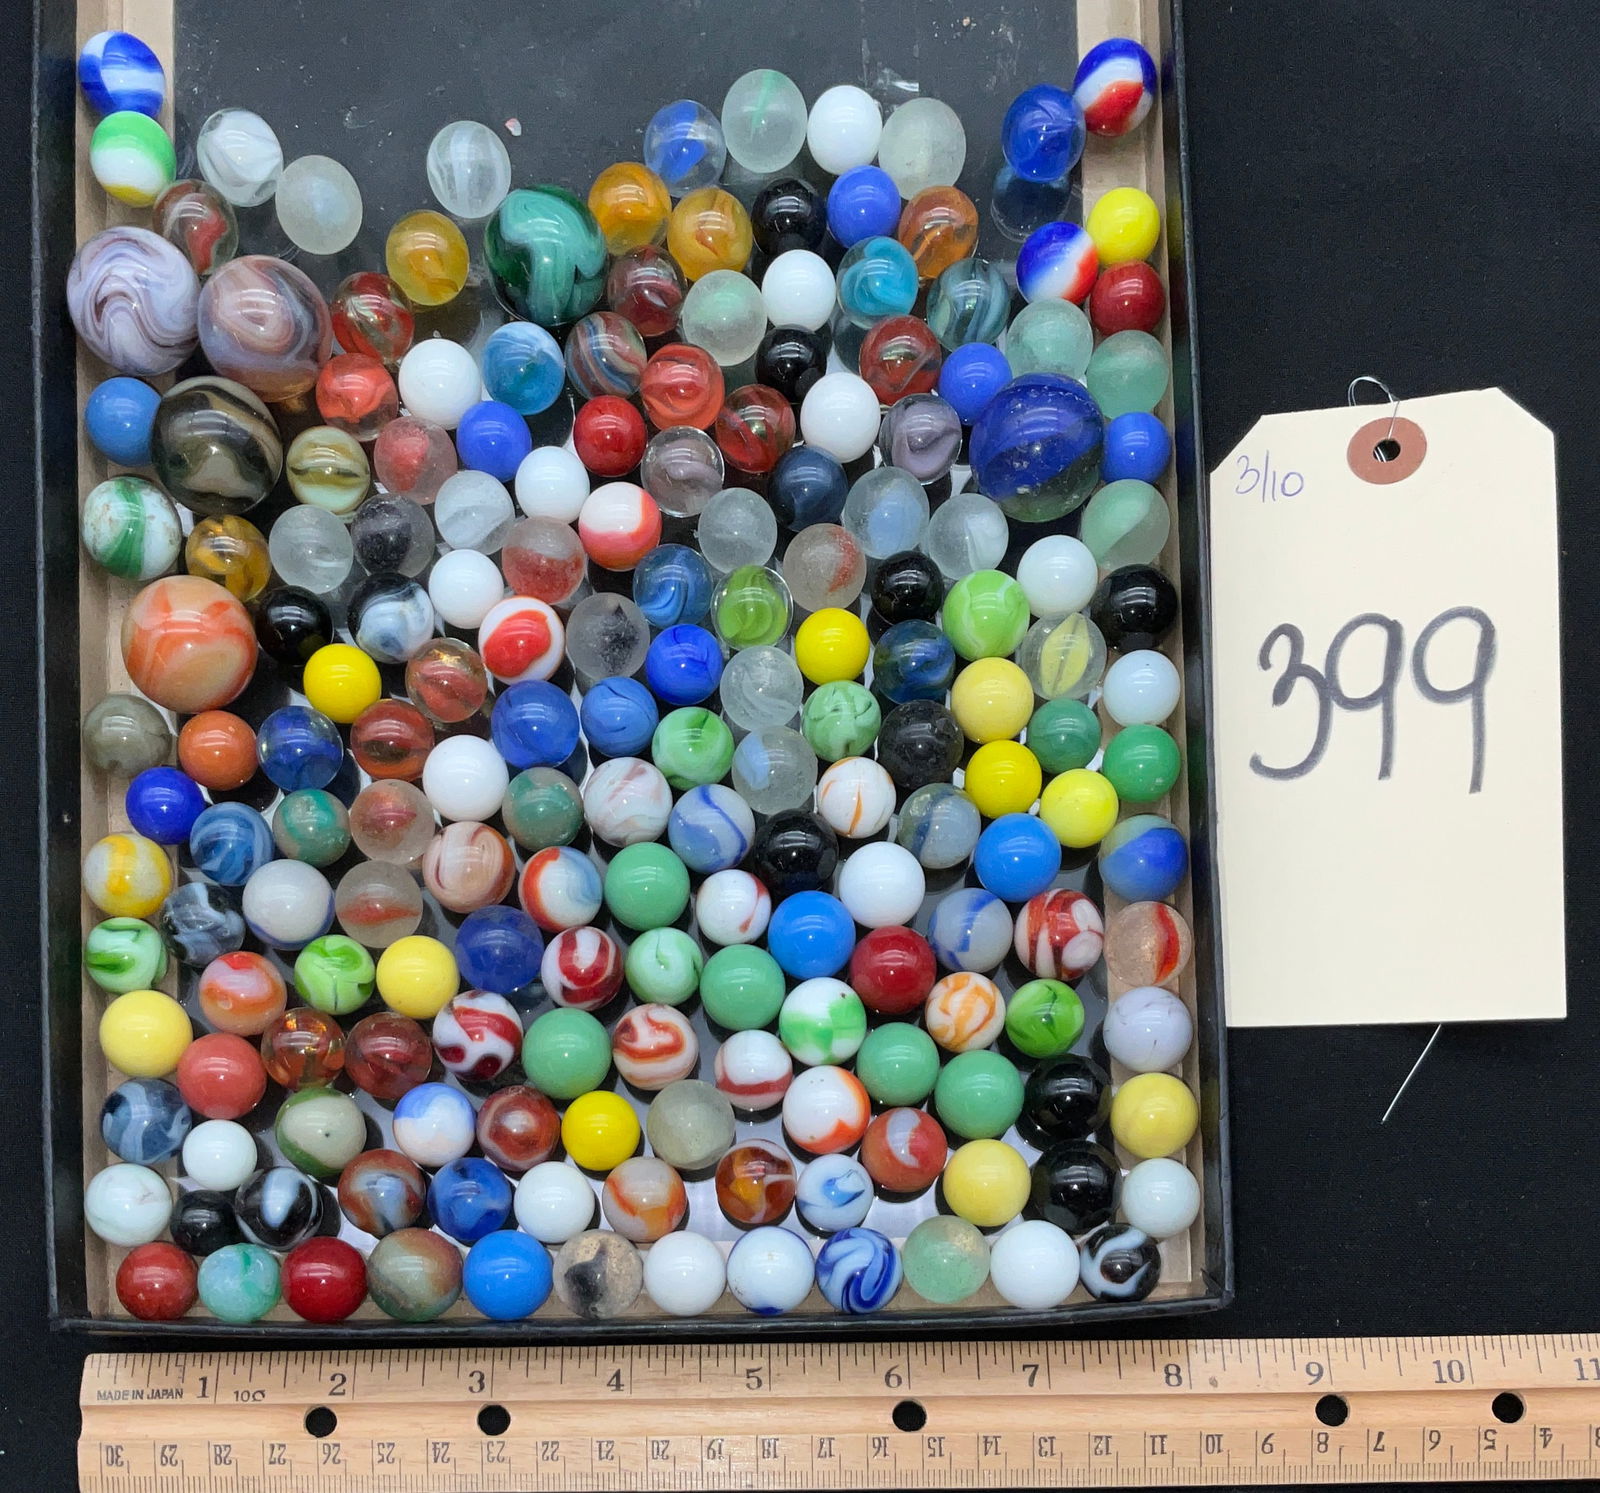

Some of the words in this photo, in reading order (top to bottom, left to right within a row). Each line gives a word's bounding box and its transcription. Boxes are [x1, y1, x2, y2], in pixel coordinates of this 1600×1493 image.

[1236, 453, 1304, 502] 3/10
[1250, 605, 1497, 796] 399
[97, 1390, 129, 1401] MADE
[131, 1390, 144, 1400] IN
[147, 1388, 183, 1400] JAPAN
[196, 1376, 211, 1399] 1
[328, 1373, 347, 1397] 2
[467, 1370, 486, 1394] 3
[606, 1368, 625, 1392] 4
[745, 1367, 763, 1391] 5
[884, 1365, 903, 1389] 6
[1021, 1364, 1040, 1388] 7
[1163, 1363, 1183, 1388] 8
[1305, 1361, 1324, 1386] 9
[1432, 1359, 1466, 1385] 10
[1573, 1357, 1600, 1381] 11
[105, 1444, 125, 1468] 30
[159, 1444, 179, 1467] 29
[213, 1444, 232, 1466] 28
[268, 1443, 287, 1466] 27
[321, 1443, 341, 1466] 26
[376, 1442, 396, 1465] 25
[431, 1441, 450, 1463] 24
[486, 1440, 506, 1463] 23
[541, 1440, 560, 1463] 22
[596, 1440, 615, 1462] 21
[651, 1439, 670, 1462] 20
[706, 1438, 725, 1461] 19
[762, 1437, 780, 1460] 18
[817, 1437, 836, 1459] 17
[871, 1436, 889, 1459] 16
[927, 1436, 946, 1458] 15
[983, 1435, 1002, 1458] 14
[1038, 1435, 1056, 1458] 13
[1094, 1435, 1113, 1457] 12
[1150, 1434, 1168, 1456] 11
[1205, 1433, 1224, 1455] 10
[1261, 1432, 1275, 1454] 9
[1316, 1432, 1329, 1453] 8
[1373, 1431, 1386, 1452] 7
[1428, 1429, 1441, 1451] 6
[1483, 1428, 1497, 1450] 5
[1539, 1427, 1553, 1449] 4
